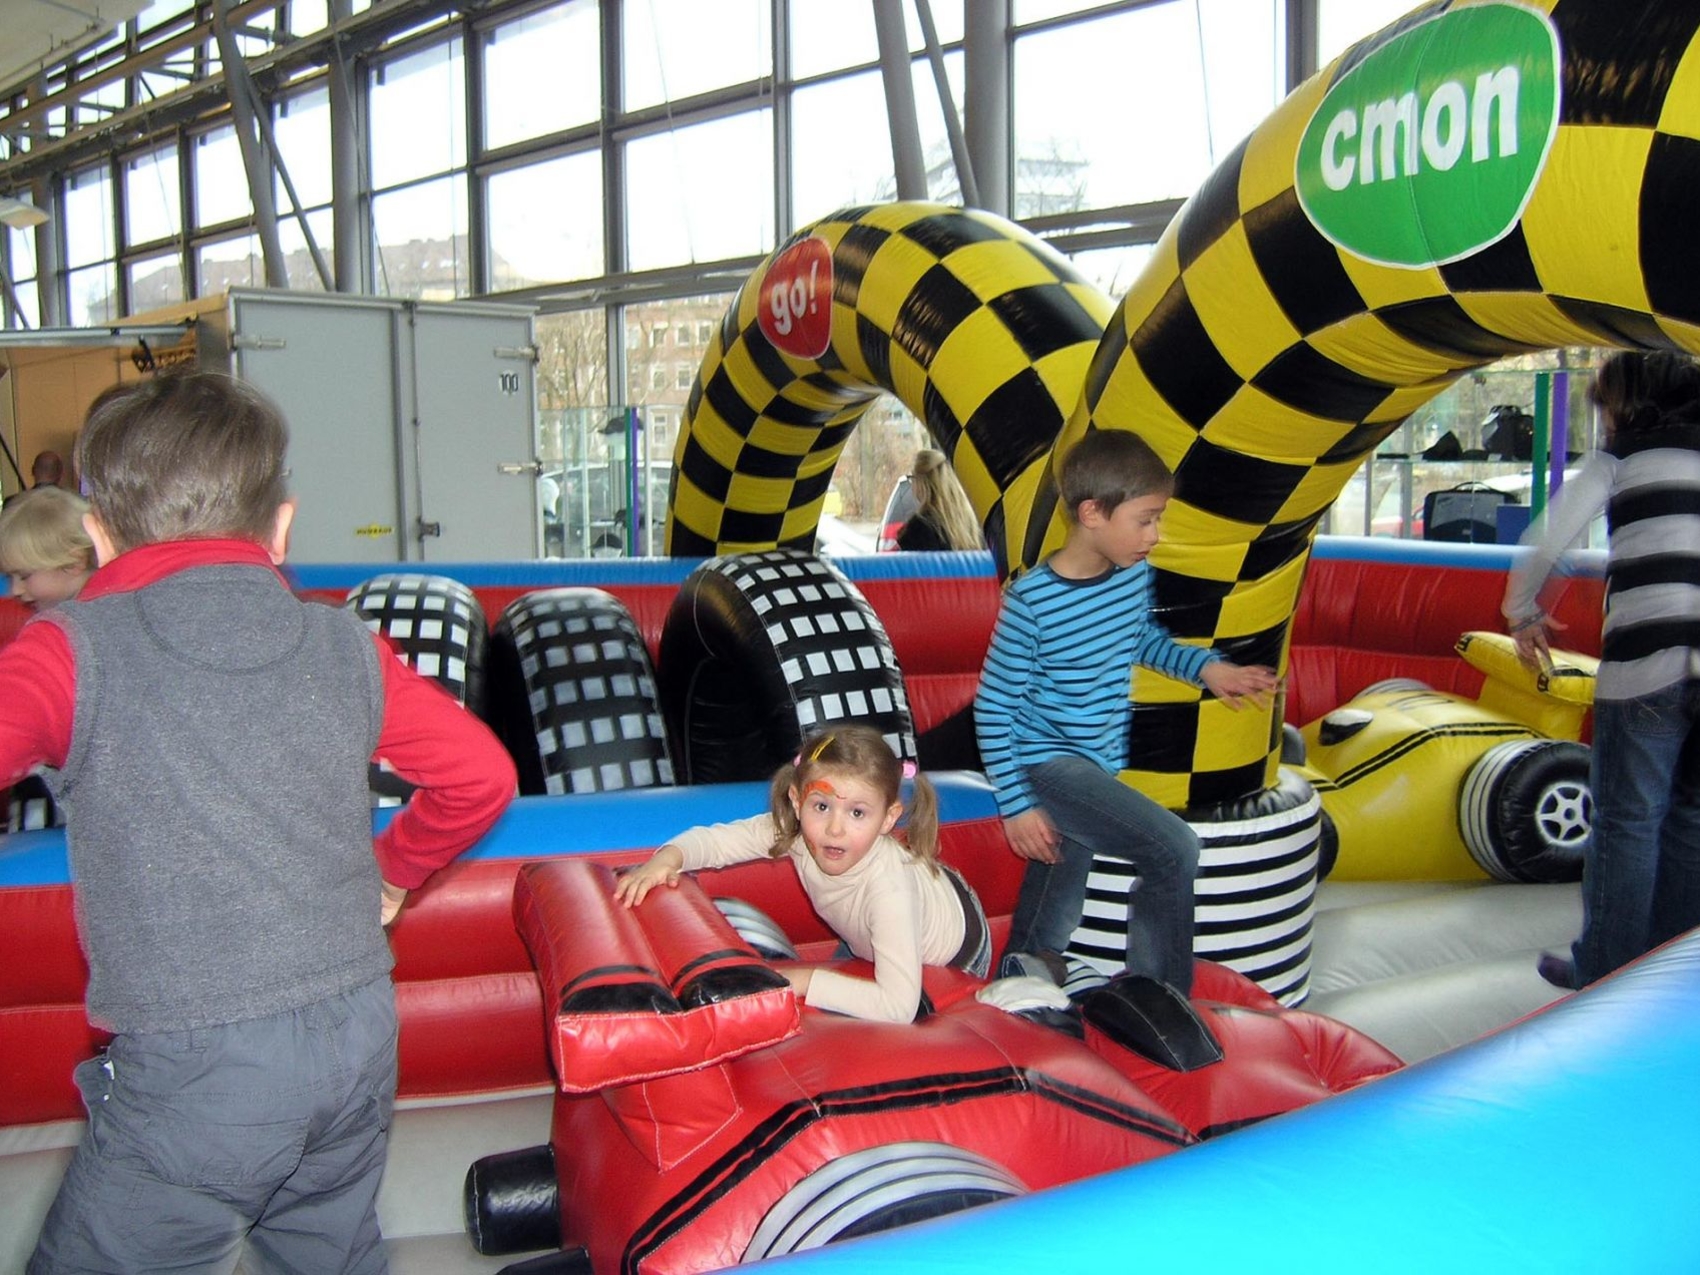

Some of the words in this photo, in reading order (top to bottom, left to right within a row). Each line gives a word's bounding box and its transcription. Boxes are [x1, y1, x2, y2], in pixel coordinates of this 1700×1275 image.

[1320, 65, 1520, 191] cmon
[771, 259, 819, 336] go!
[500, 373, 519, 392] 100
